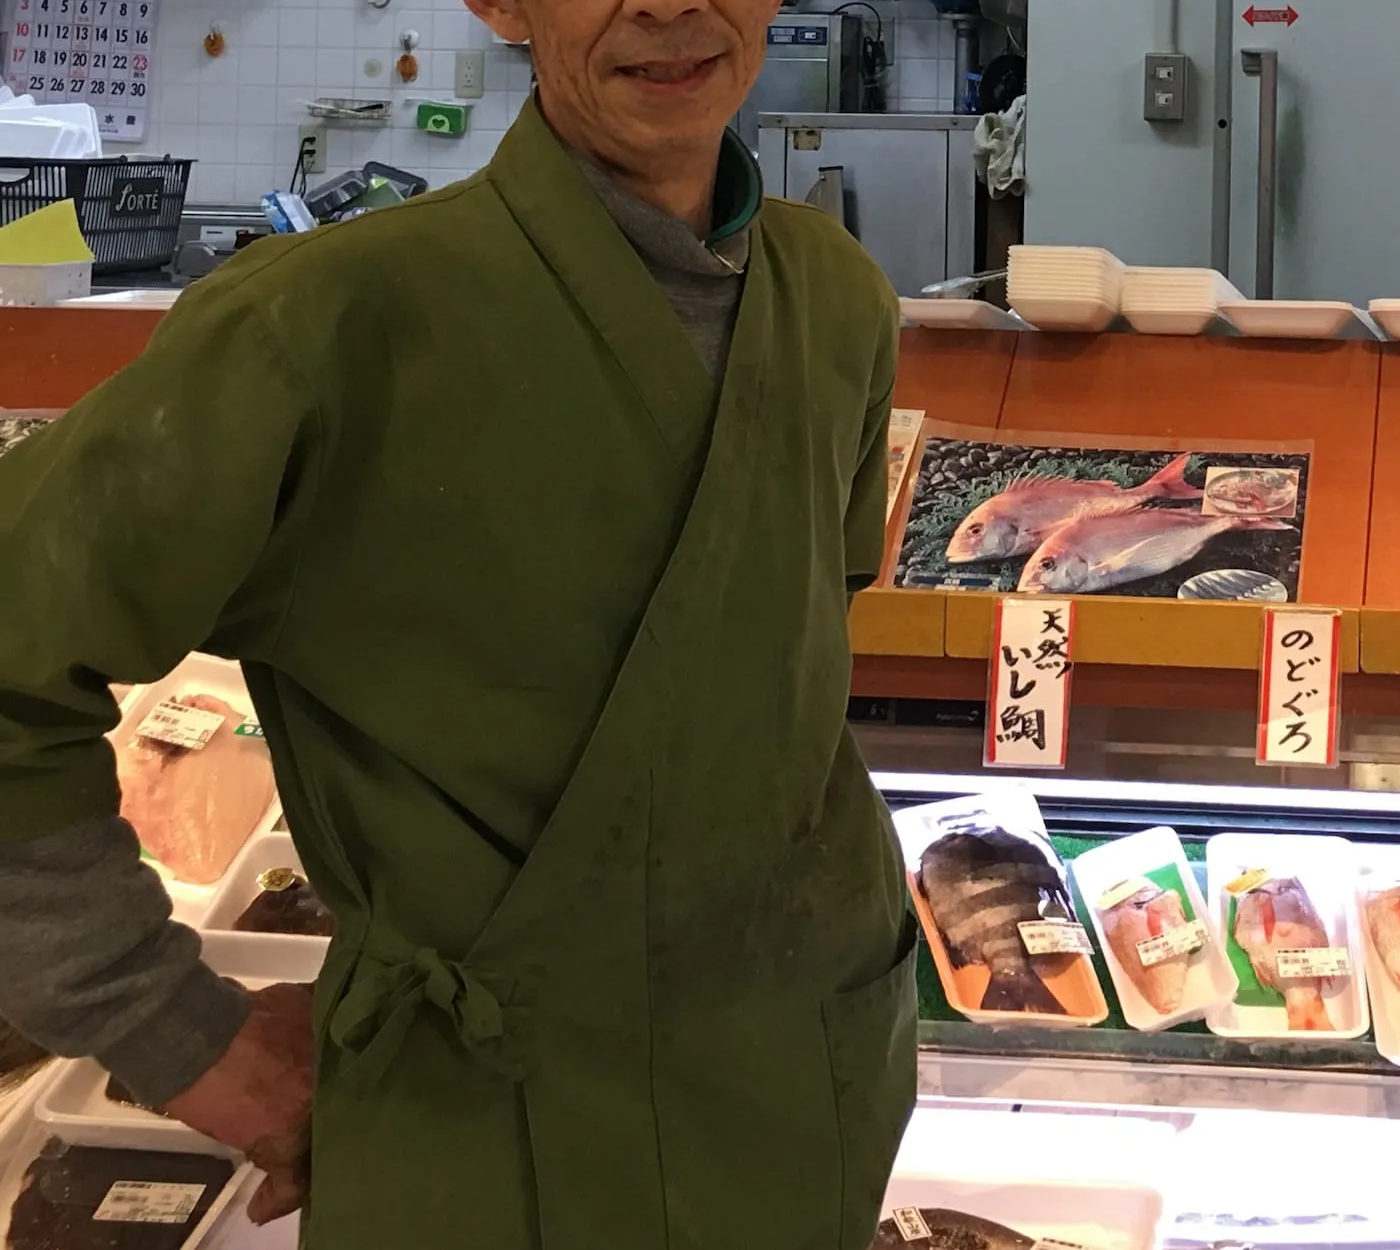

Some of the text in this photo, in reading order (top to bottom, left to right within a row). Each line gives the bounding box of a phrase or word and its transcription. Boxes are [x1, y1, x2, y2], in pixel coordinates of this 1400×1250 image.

[61, 0, 69, 13] 5
[80, 1, 88, 14] 6
[100, 2, 107, 15] 7
[120, 3, 127, 16] 8
[140, 4, 148, 18] 9
[16, 23, 148, 44] 10 11 12 13 14 15 16
[13, 49, 148, 70] 17 18 19 20 21 22 23
[30, 77, 44, 90] 25
[50, 78, 65, 92] 26
[70, 79, 85, 93] 27
[91, 81, 105, 95] 28
[111, 82, 126, 96] 29
[131, 83, 146, 97] 30
[1032, 608, 1073, 678] 天然
[997, 646, 1045, 749] いし鯛
[1278, 630, 1320, 753] のどぐろ
